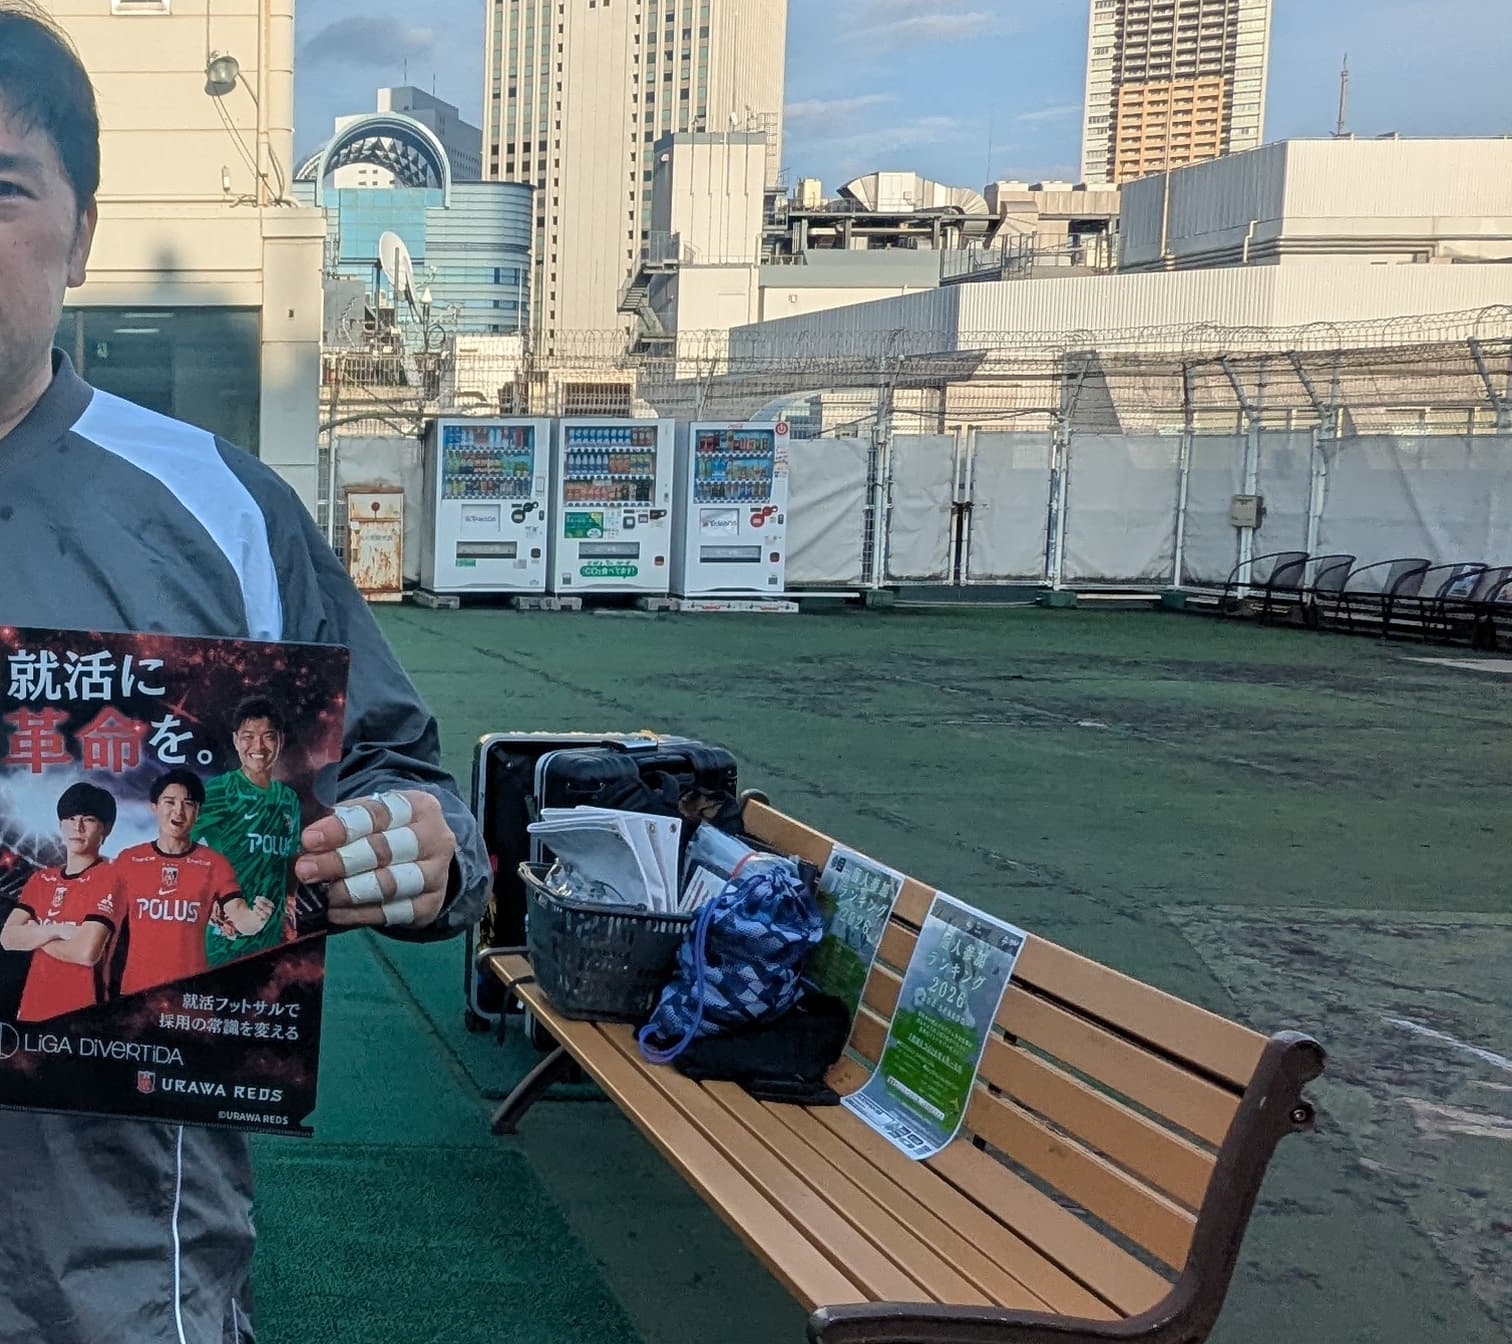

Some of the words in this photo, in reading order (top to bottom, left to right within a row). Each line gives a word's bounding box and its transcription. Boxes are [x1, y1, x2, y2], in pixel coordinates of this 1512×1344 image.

[7, 649, 166, 701] 就活に
[136, 898, 201, 923] POLUS
[928, 952, 987, 991] ランキング
[181, 992, 301, 1018] 就活フットサルで
[929, 976, 966, 1009] 2026
[158, 1012, 300, 1041] 採用の常識を変える
[161, 1077, 226, 1097] URAWA
[233, 1085, 284, 1102] REDS
[262, 1114, 289, 1125] REDS
